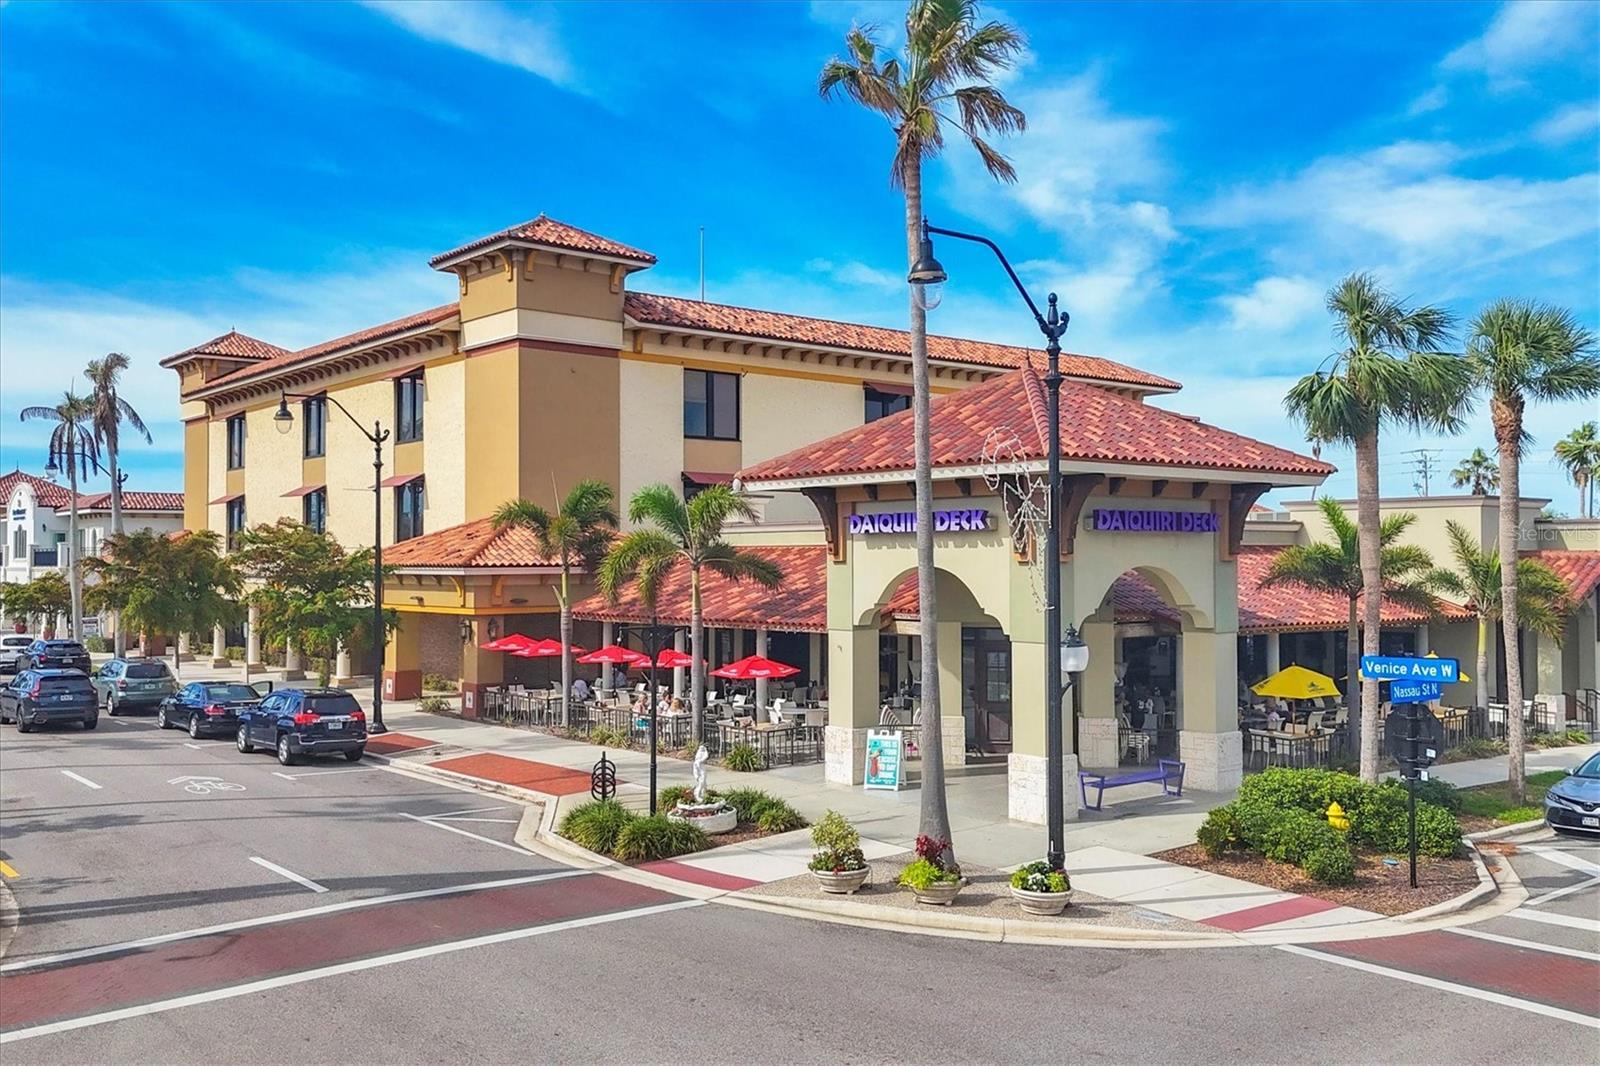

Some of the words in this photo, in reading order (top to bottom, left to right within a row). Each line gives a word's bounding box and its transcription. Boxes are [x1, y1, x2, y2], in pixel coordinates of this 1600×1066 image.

[849, 512, 917, 534] DAIQUI
[934, 510, 987, 531] DECK
[1097, 509, 1177, 531] DAIQUIRI
[1181, 512, 1218, 532] DECK
[1365, 661, 1407, 675] Venice
[1411, 663, 1437, 676] Ave
[1441, 664, 1452, 677] W
[1394, 686, 1420, 698] Nassau
[1422, 683, 1430, 696] St
[1432, 682, 1438, 694] N
